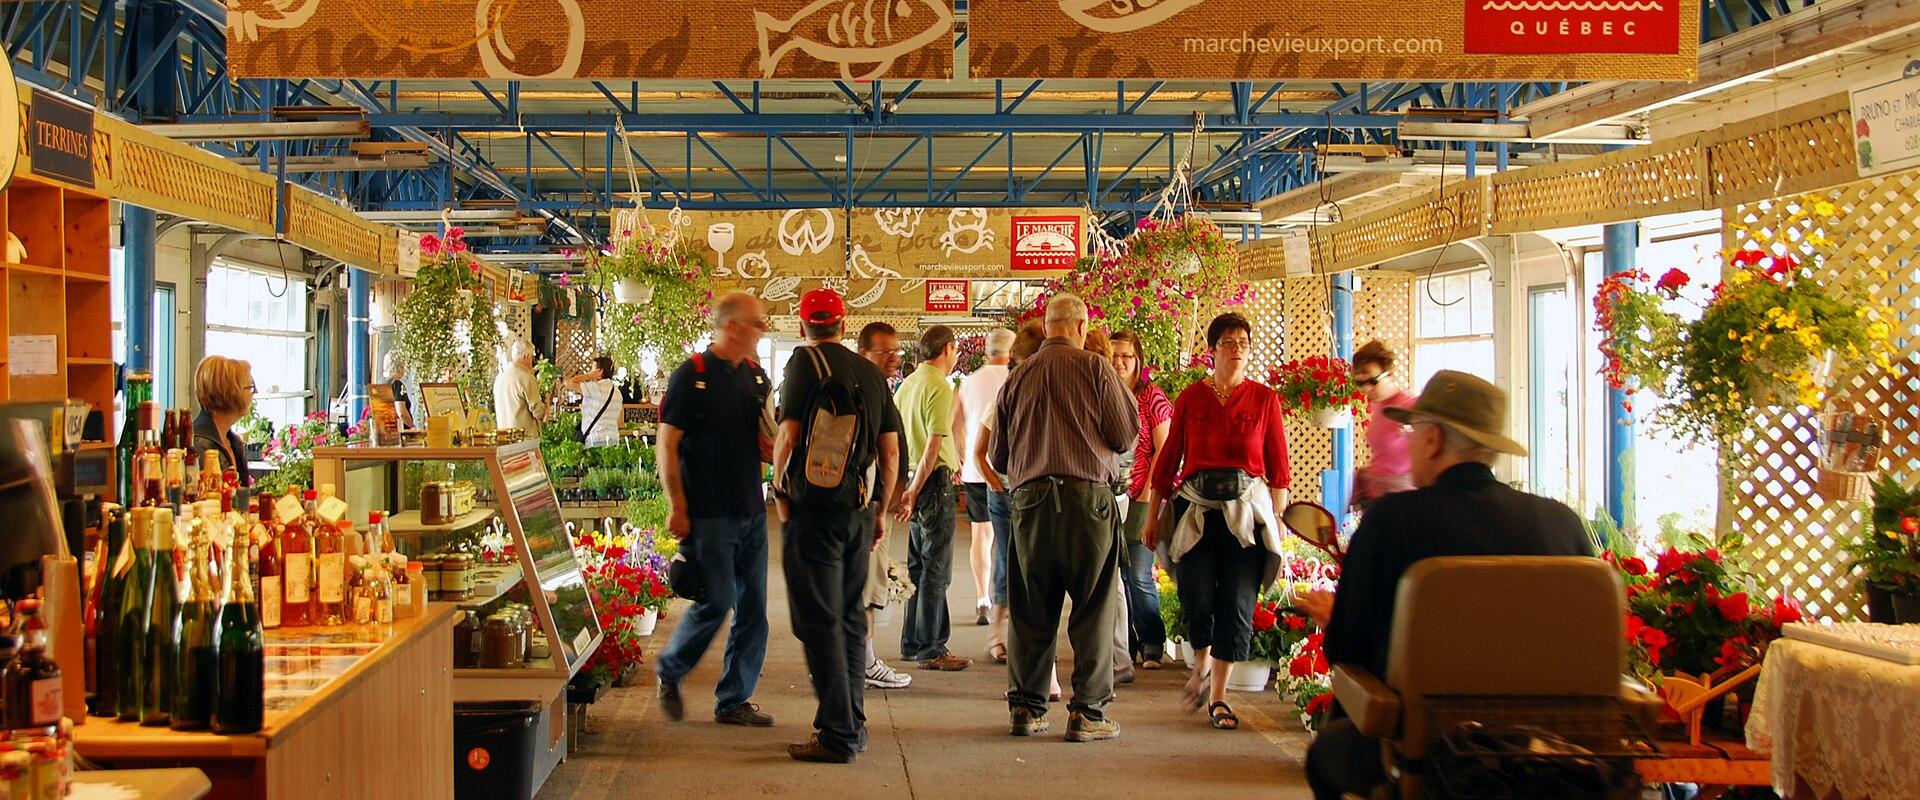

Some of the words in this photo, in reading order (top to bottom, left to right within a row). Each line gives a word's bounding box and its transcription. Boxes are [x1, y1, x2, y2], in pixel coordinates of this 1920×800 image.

[1510, 18, 1636, 35] QUÉBEC
[1184, 31, 1442, 60] marchevieuxport.com
[37, 120, 88, 158] TERRINES
[1016, 225, 1030, 241] LE
[919, 257, 1004, 271] marchevieuxport.com
